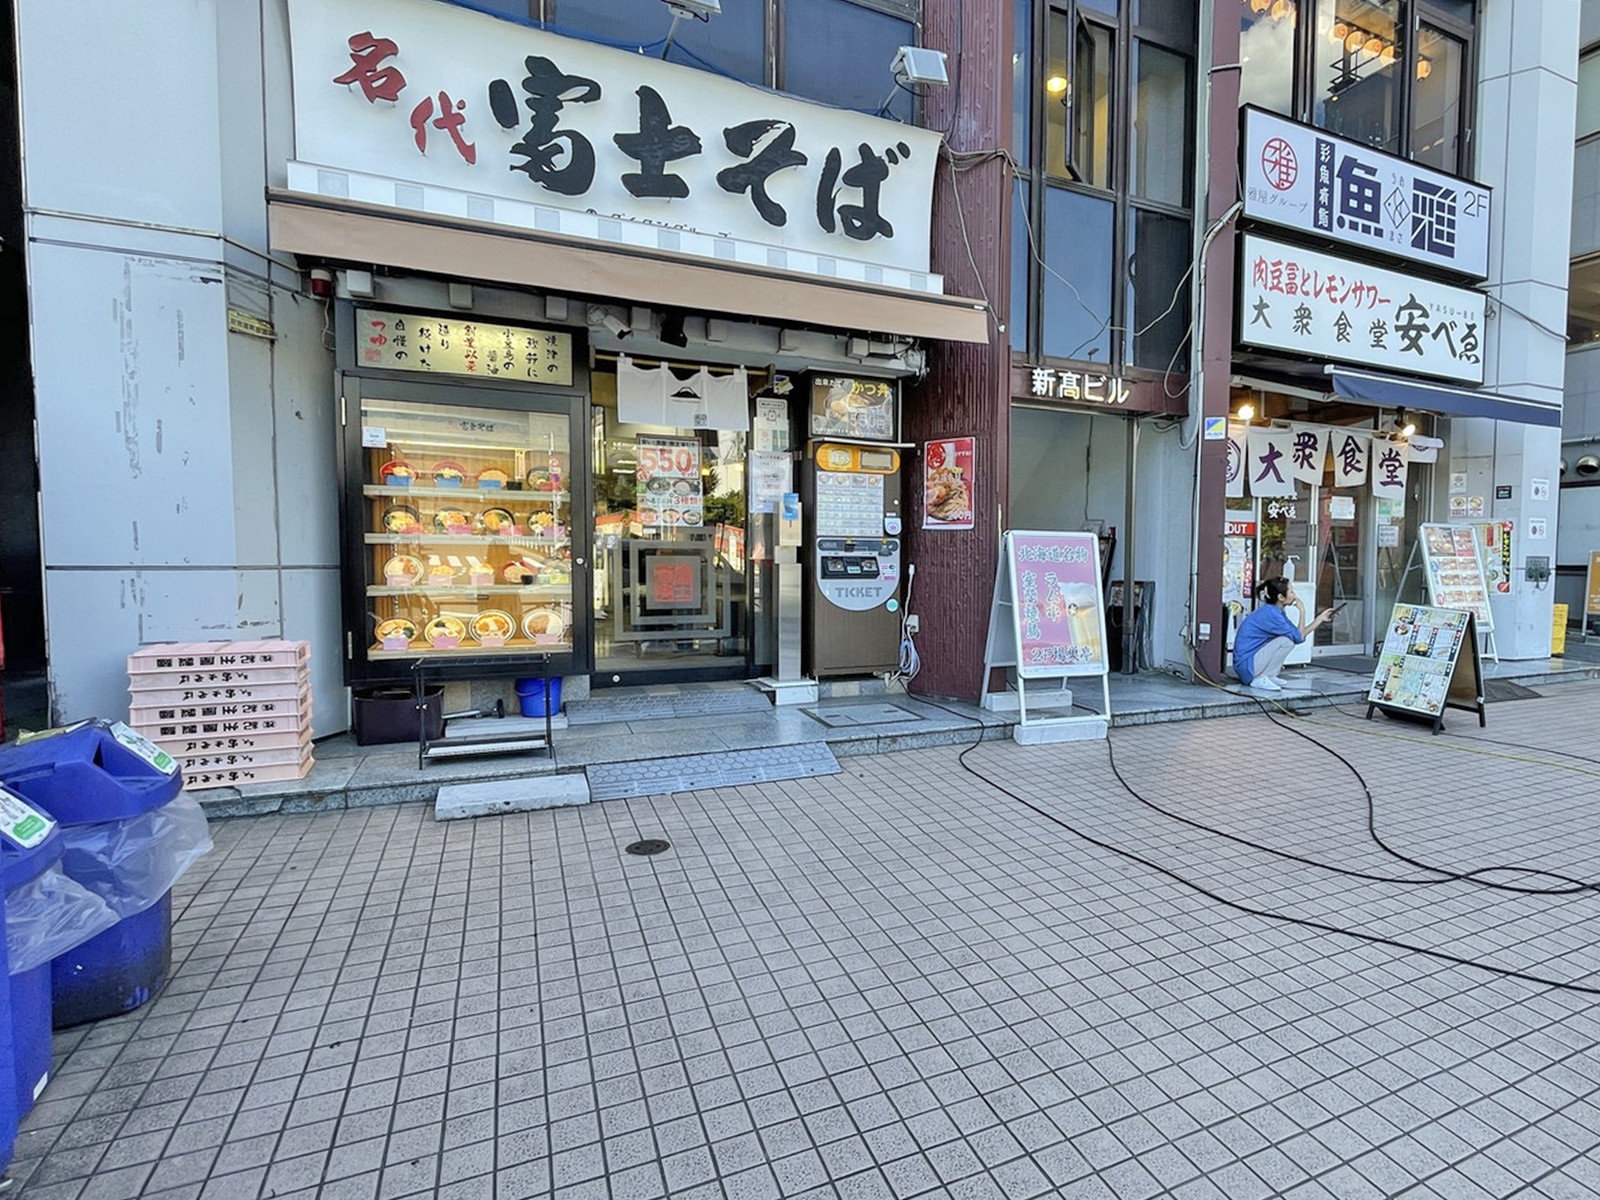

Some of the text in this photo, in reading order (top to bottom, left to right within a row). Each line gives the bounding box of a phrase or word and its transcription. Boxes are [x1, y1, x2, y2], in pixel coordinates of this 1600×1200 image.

[1463, 190, 1488, 218] 2F
[370, 321, 387, 346] つゆ
[1250, 295, 1389, 350] 大衆食堂
[853, 381, 890, 397] かつ丼
[641, 447, 692, 473] 550
[1254, 431, 1405, 488] 大衆食堂
[1018, 545, 1089, 563] 北海道名物
[834, 586, 883, 598] TICKET
